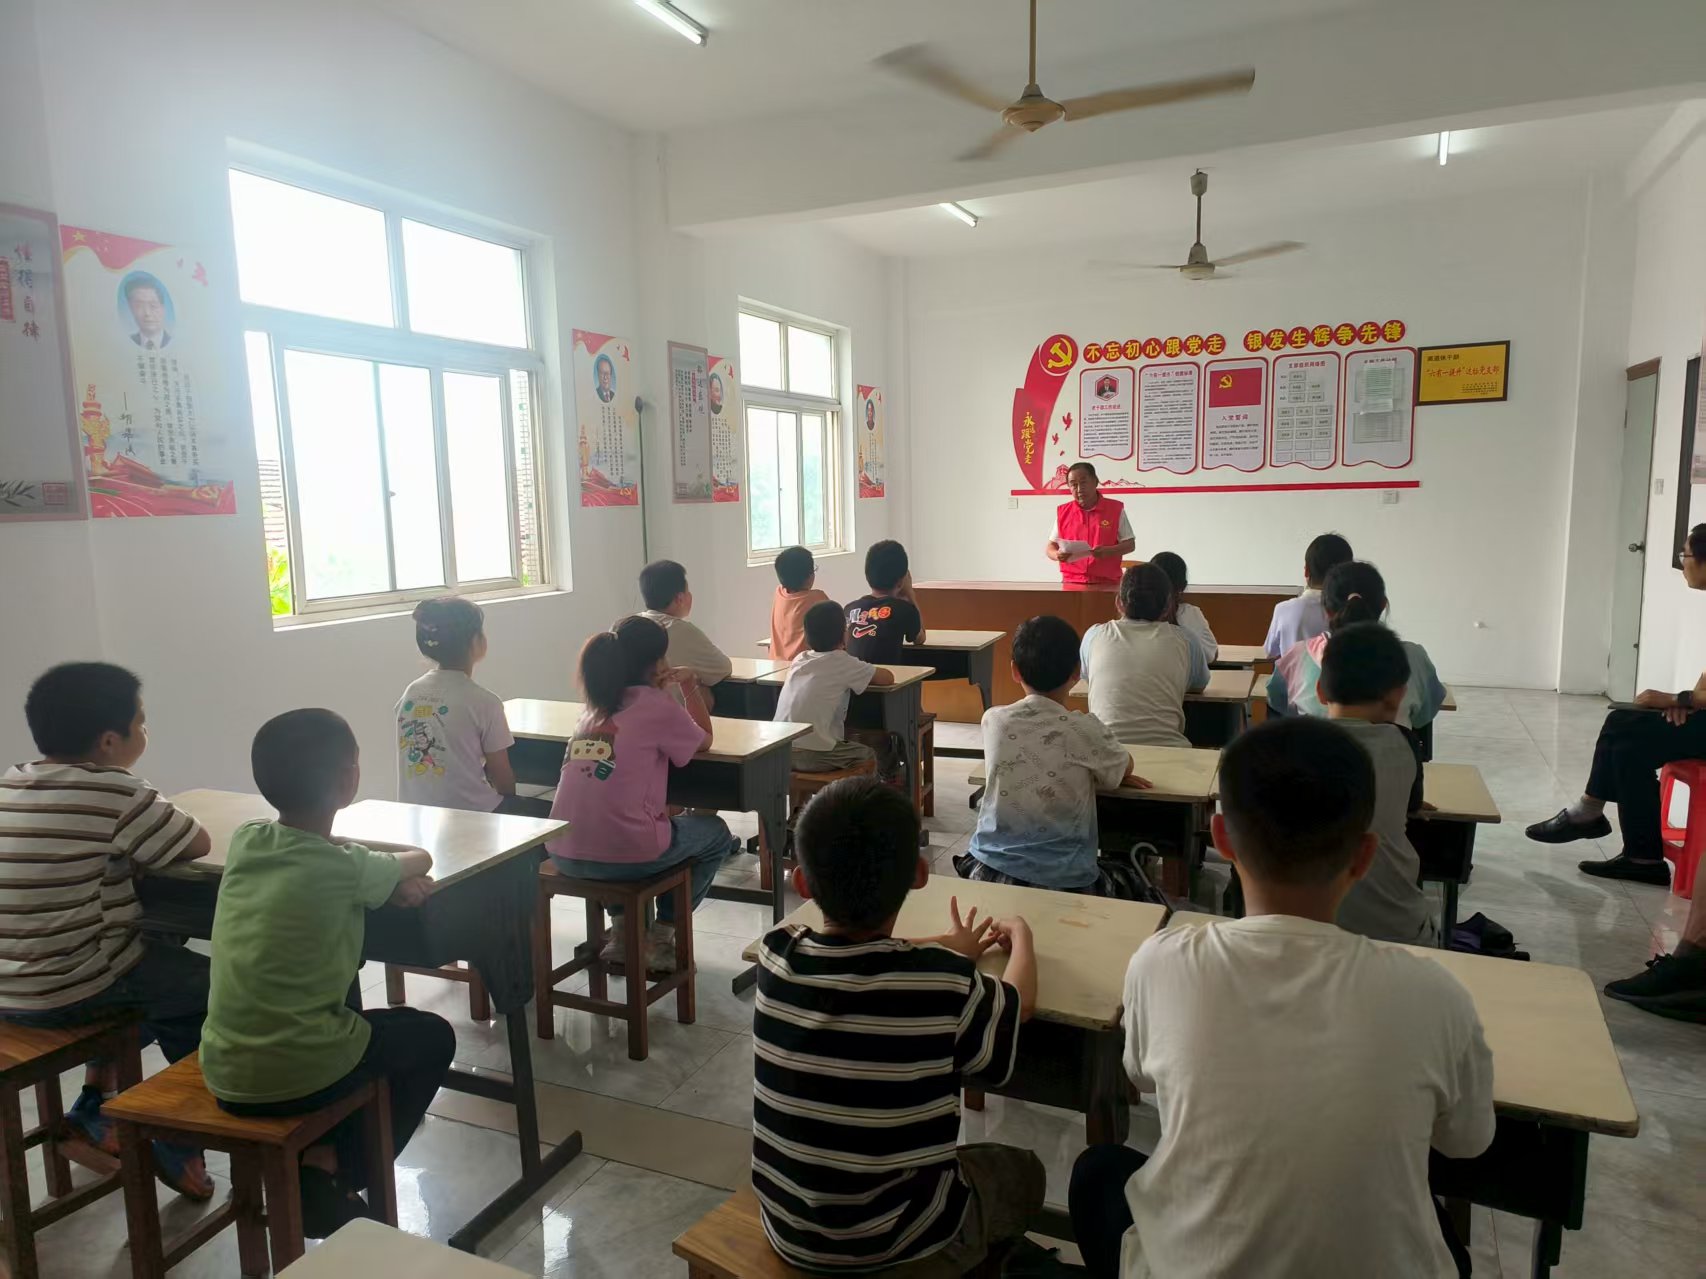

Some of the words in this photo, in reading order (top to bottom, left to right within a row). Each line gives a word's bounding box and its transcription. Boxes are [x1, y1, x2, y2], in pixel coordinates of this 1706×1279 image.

[1087, 335, 1223, 361] 不忘初心跟党走
[1247, 321, 1402, 350] 银发生辉争先锋
